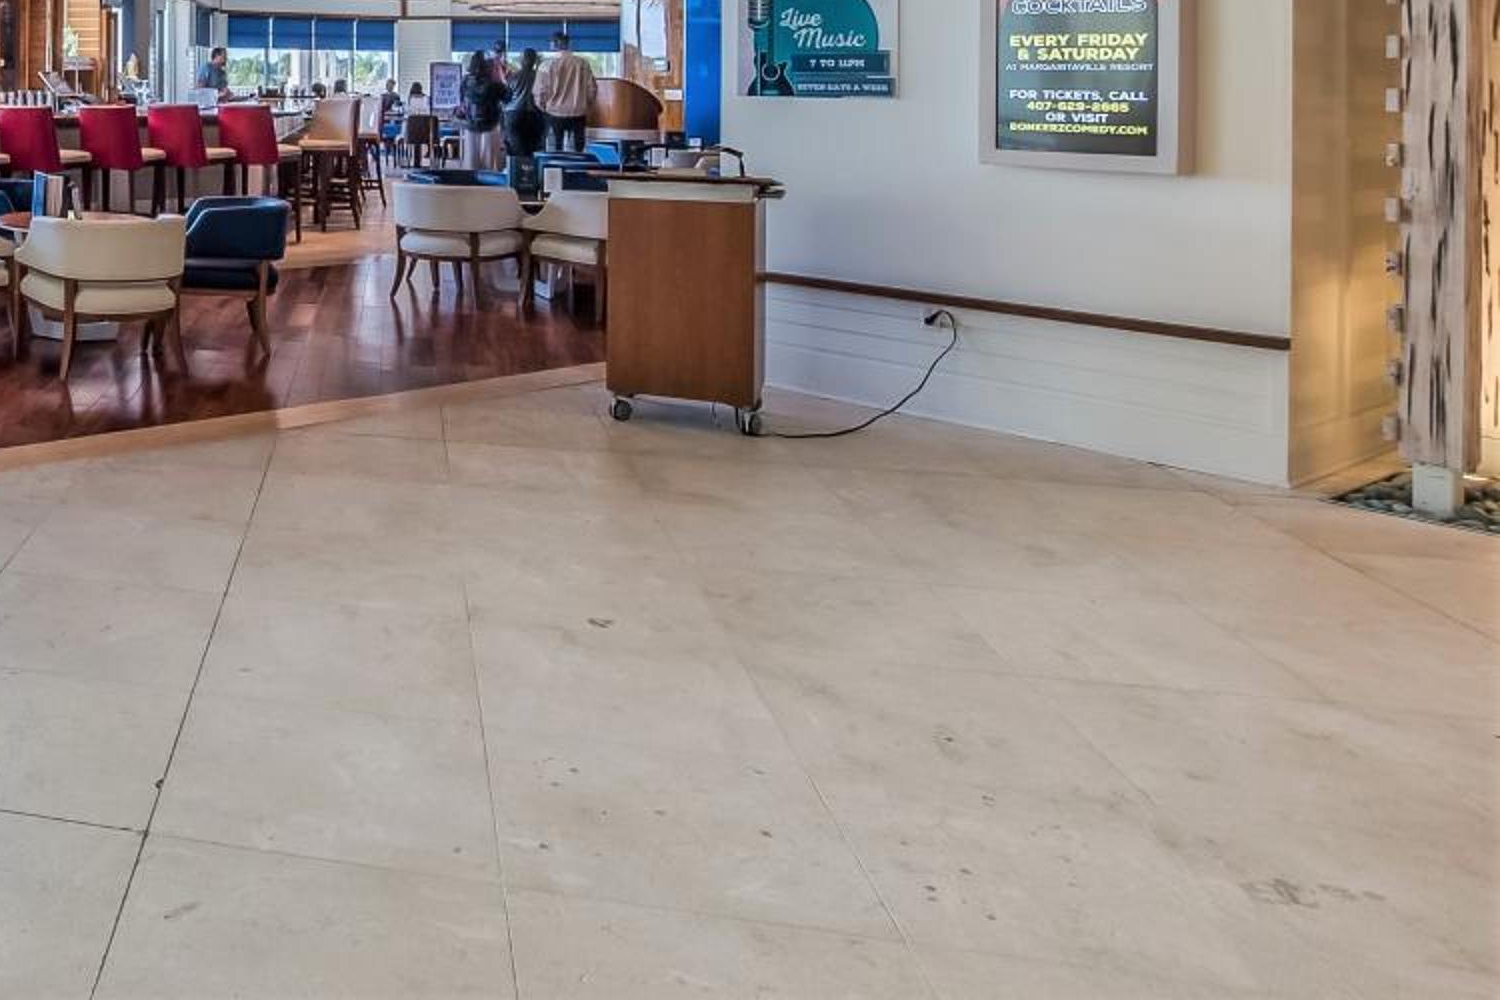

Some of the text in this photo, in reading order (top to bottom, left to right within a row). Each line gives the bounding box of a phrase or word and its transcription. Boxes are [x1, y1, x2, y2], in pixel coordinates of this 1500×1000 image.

[779, 8, 822, 30] Live
[793, 27, 867, 49] Music
[1009, 33, 1149, 47] EVERY FRIDAY
[1017, 47, 1140, 61] & SATURDAY
[819, 59, 835, 67] TO
[1020, 63, 1106, 71] MARGARITAVILLE
[1109, 63, 1153, 71] RESORT
[853, 83, 861, 91] A
[1009, 90, 1149, 101] FOR TICKETS, CALL
[1045, 112, 1108, 123] OR VISIT
[1009, 122, 1149, 135] BONKERZCOMEDY.COM
